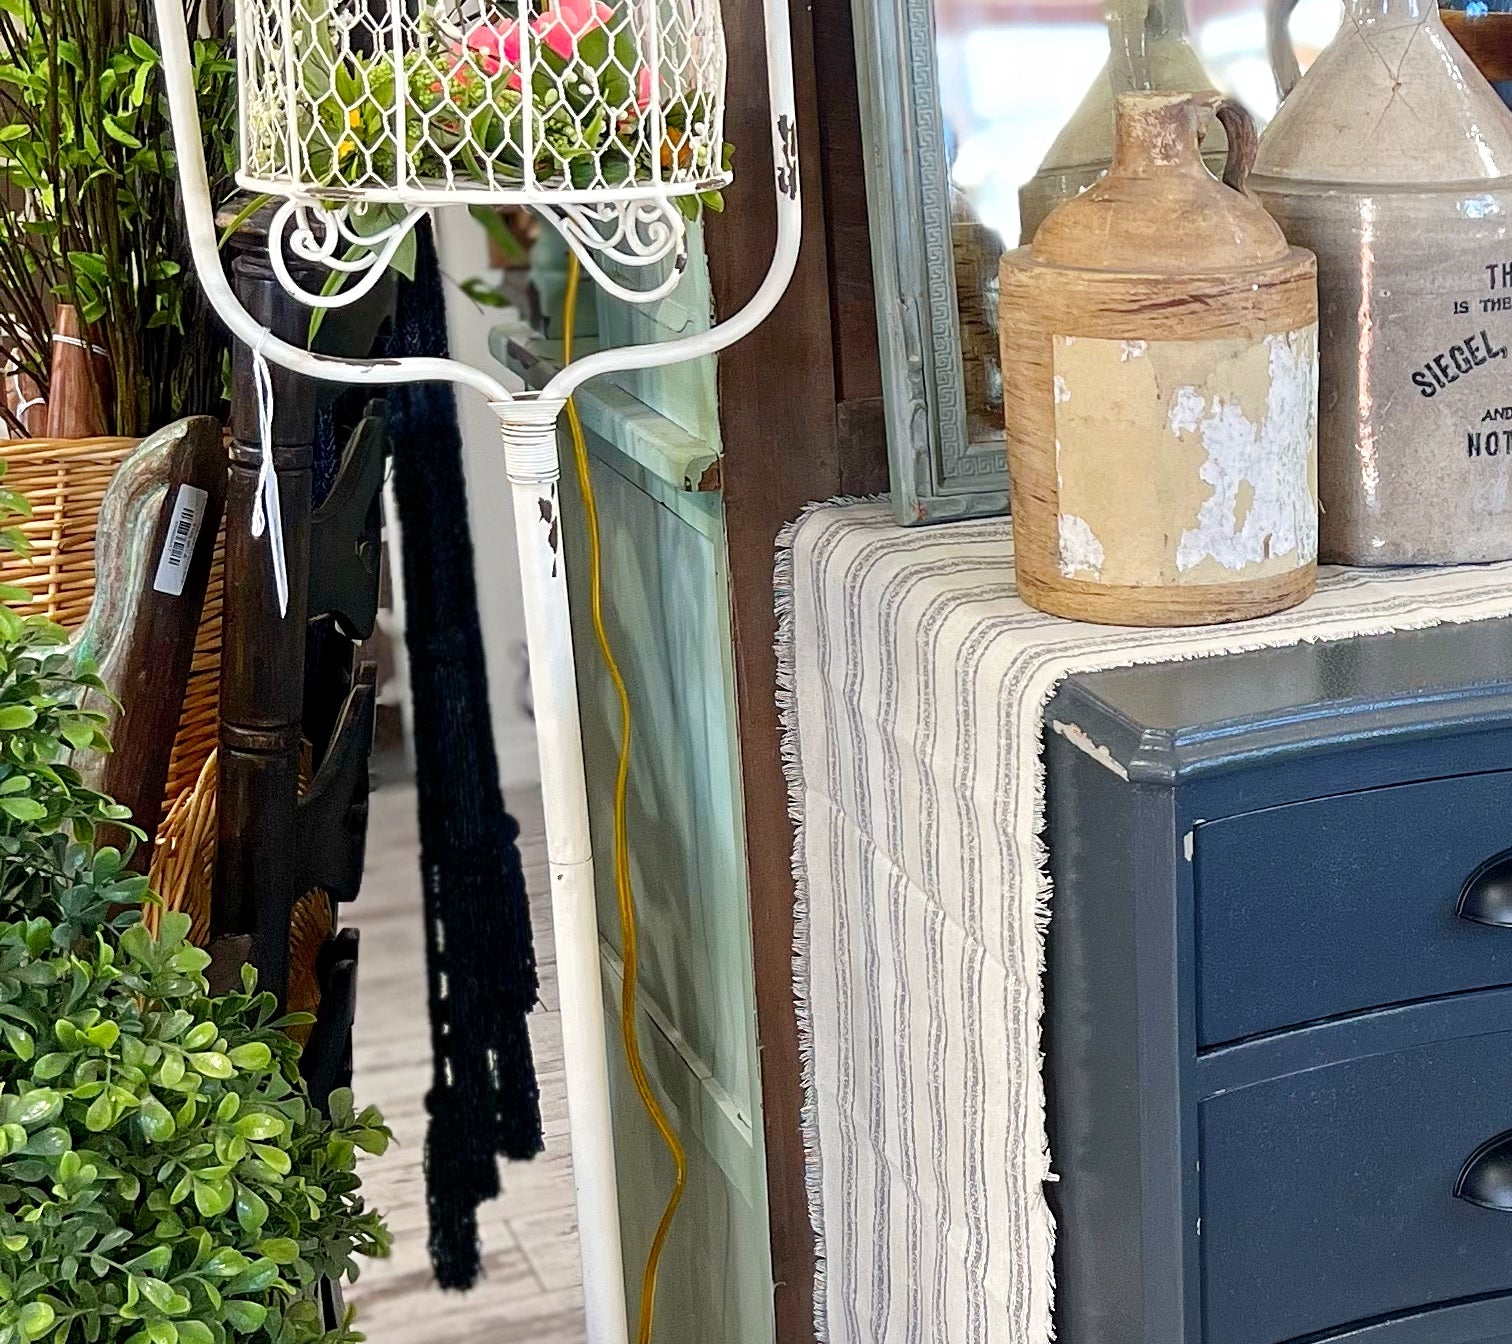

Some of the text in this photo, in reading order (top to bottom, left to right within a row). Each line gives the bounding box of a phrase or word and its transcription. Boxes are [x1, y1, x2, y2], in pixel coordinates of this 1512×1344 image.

[1453, 301, 1469, 314] IS
[1479, 297, 1512, 312] THE
[1411, 329, 1508, 397] SIEGEL,
